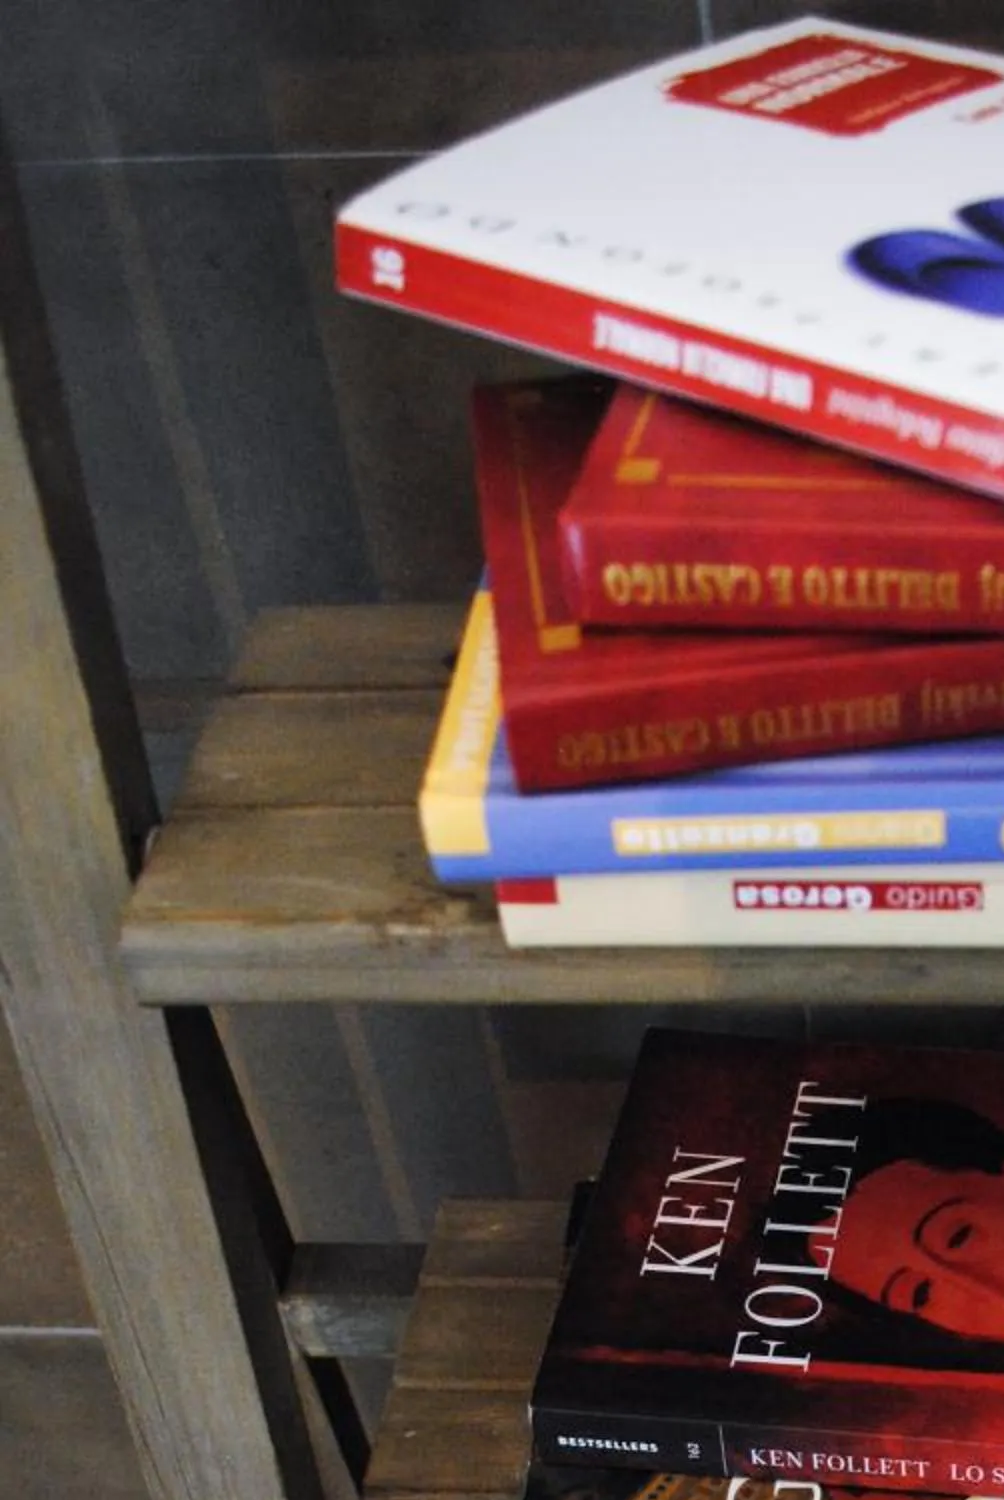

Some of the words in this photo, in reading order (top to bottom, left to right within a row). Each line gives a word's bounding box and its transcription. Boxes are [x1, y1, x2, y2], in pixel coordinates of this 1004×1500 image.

[603, 562, 762, 605] CASTIGO
[774, 566, 792, 602] E
[803, 566, 960, 611] DELITTO
[750, 695, 901, 744] DELITTO
[556, 718, 711, 770] CASTIGO
[737, 882, 873, 911] Gerosa
[885, 886, 983, 911] Guido
[640, 1145, 747, 1281] KEN
[730, 1080, 867, 1373] FOLLETT
[557, 1435, 659, 1454] BESTSELLERS
[750, 1447, 804, 1470] KEN
[811, 1452, 932, 1479] FOLLETT
[949, 1463, 985, 1484] LO
